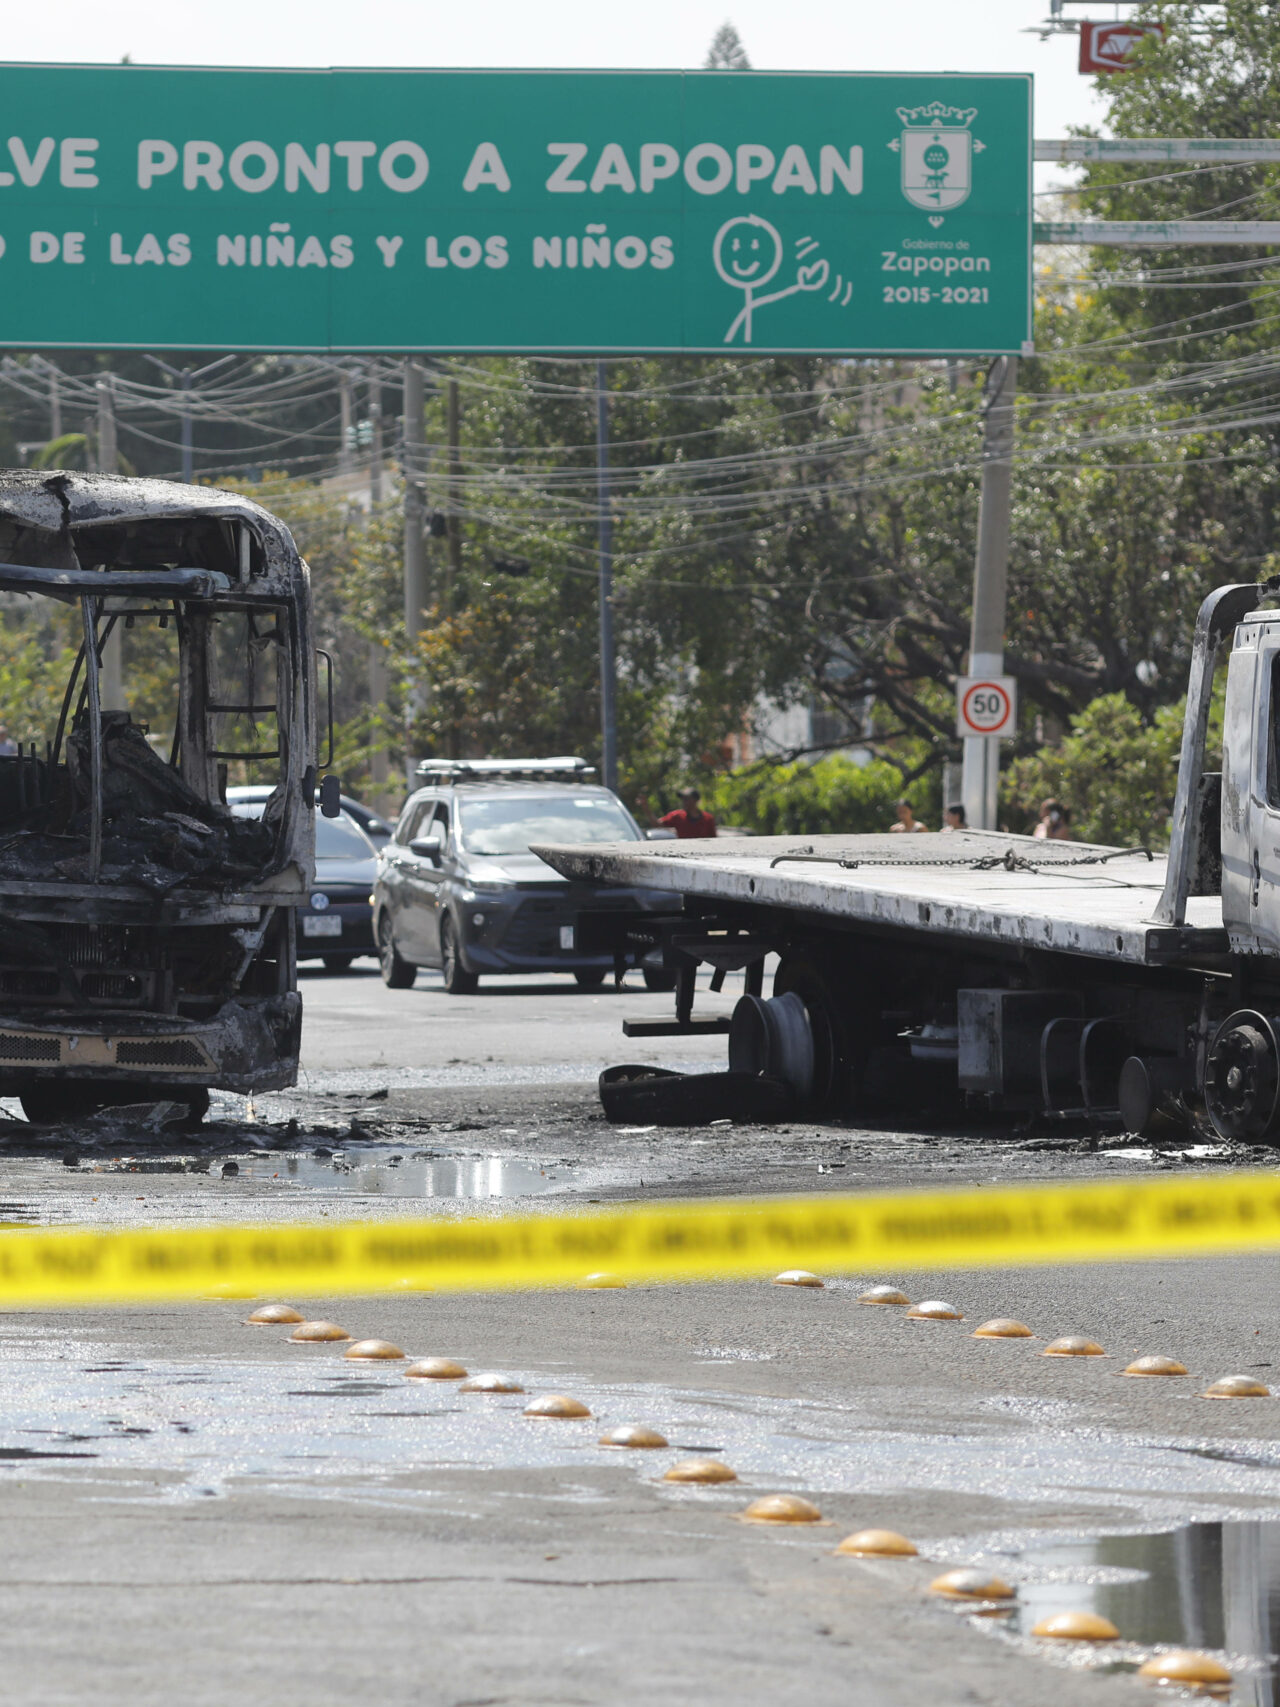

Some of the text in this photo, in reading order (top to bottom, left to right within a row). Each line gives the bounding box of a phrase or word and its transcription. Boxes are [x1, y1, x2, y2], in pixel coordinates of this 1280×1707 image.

[137, 139, 430, 194] PRONTO
[462, 141, 511, 193] A
[545, 142, 864, 195] ZAPOPAN
[29, 231, 86, 264] DE
[110, 232, 192, 267] LAS
[217, 222, 354, 269] NIÑAS
[375, 235, 403, 268] Y
[425, 235, 509, 269] LOS
[533, 223, 675, 270] NIÑOS
[902, 239, 970, 250] Gobierno de
[881, 251, 990, 277] Zapopan
[883, 286, 989, 304] 2015-2021
[974, 694, 1000, 714] 50
